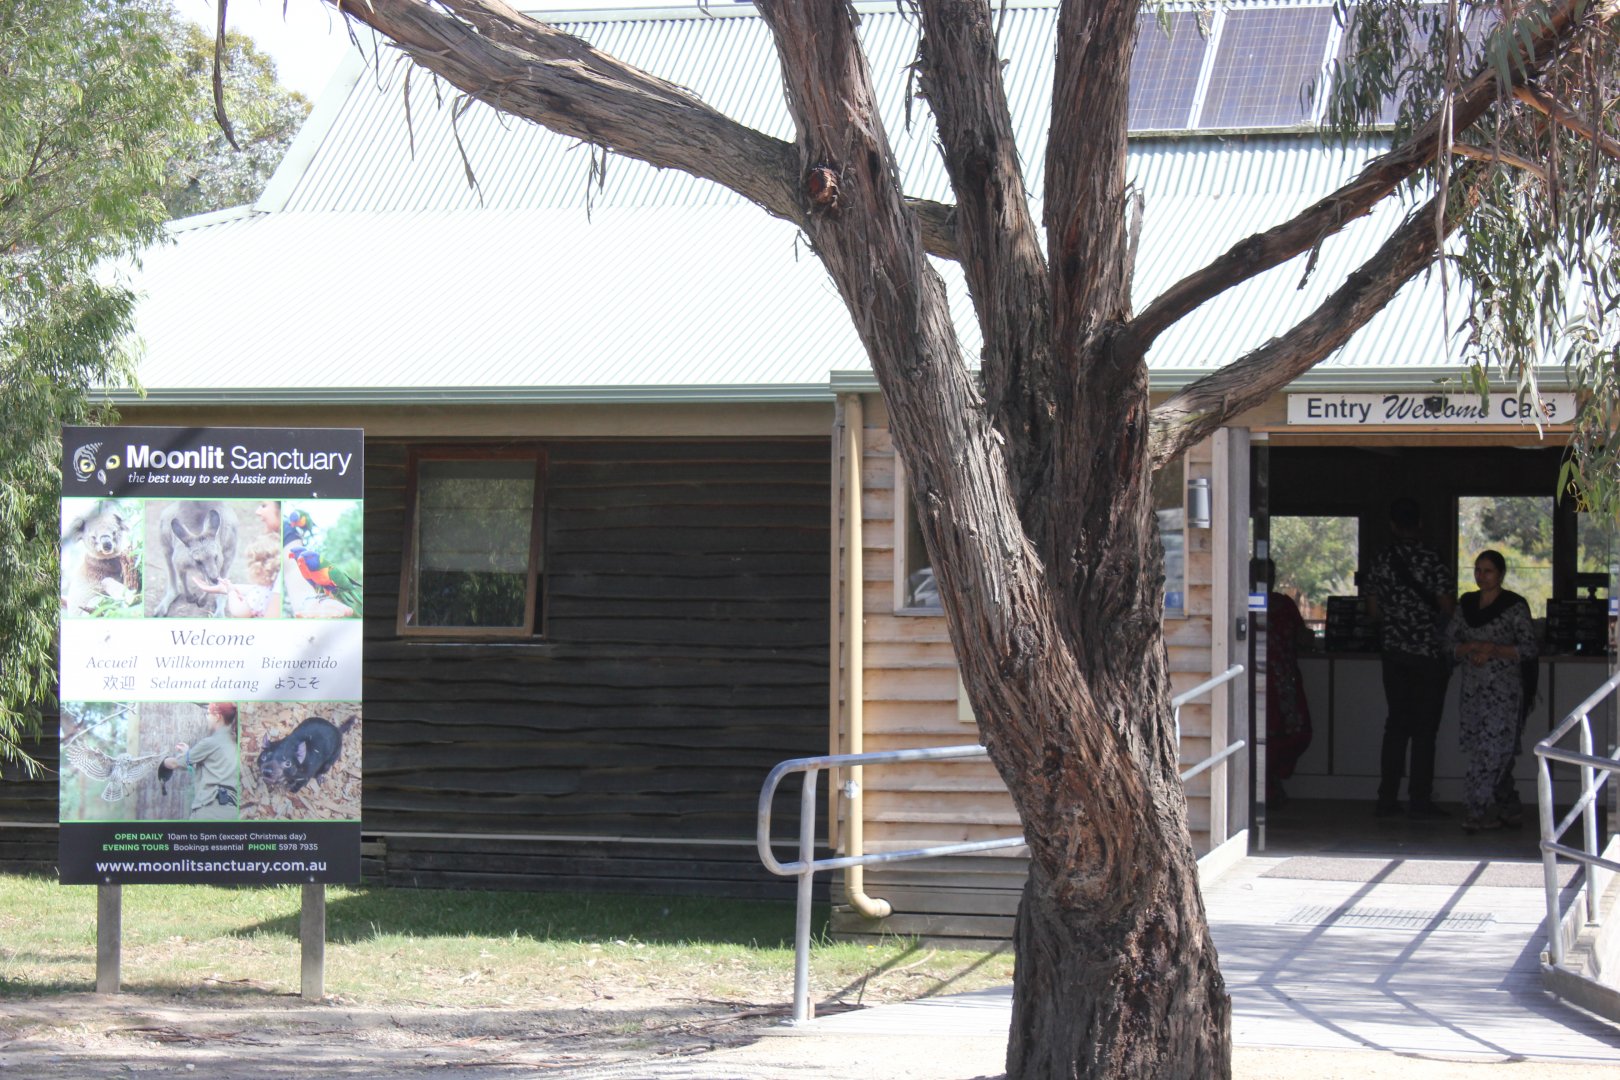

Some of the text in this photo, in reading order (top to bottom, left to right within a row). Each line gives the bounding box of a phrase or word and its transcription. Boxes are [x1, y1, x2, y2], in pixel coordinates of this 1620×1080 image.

[1307, 398, 1371, 423] Entry
[1501, 397, 1557, 418] Caé
[126, 445, 353, 476] Moonlit Sanctuary
[128, 472, 312, 486] the best way to see Aussie animals
[170, 629, 255, 646] Welcome
[85, 656, 338, 669] Accueil Willkommen Bienvenido
[103, 675, 136, 691] 欢迎
[150, 676, 259, 692] Selamat datang
[274, 676, 320, 690] ようこそ
[200, 833, 217, 842] 5pm
[219, 833, 248, 841] (except
[289, 833, 307, 841] day)
[173, 844, 209, 852] Bookings
[96, 859, 327, 873] www.moonlitsanctuary.com.au
